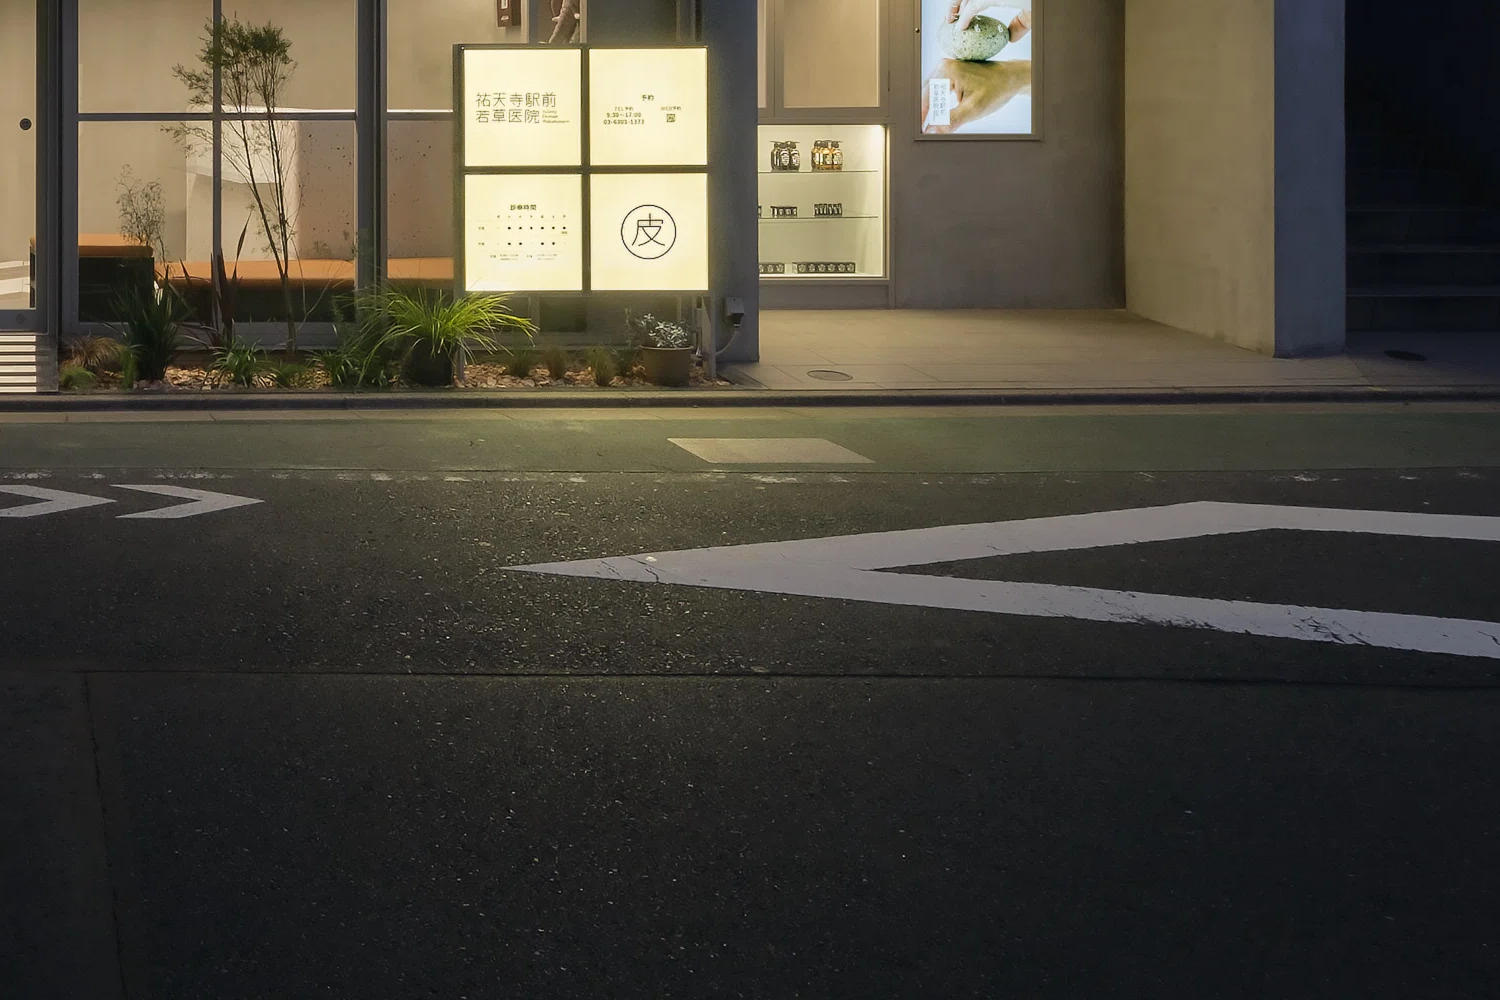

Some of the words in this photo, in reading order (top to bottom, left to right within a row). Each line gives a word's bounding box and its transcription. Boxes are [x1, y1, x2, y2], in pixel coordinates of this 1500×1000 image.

[475, 92, 557, 108] 祐天寺駅前
[475, 109, 540, 124] 若草医院
[631, 212, 666, 247] 皮
